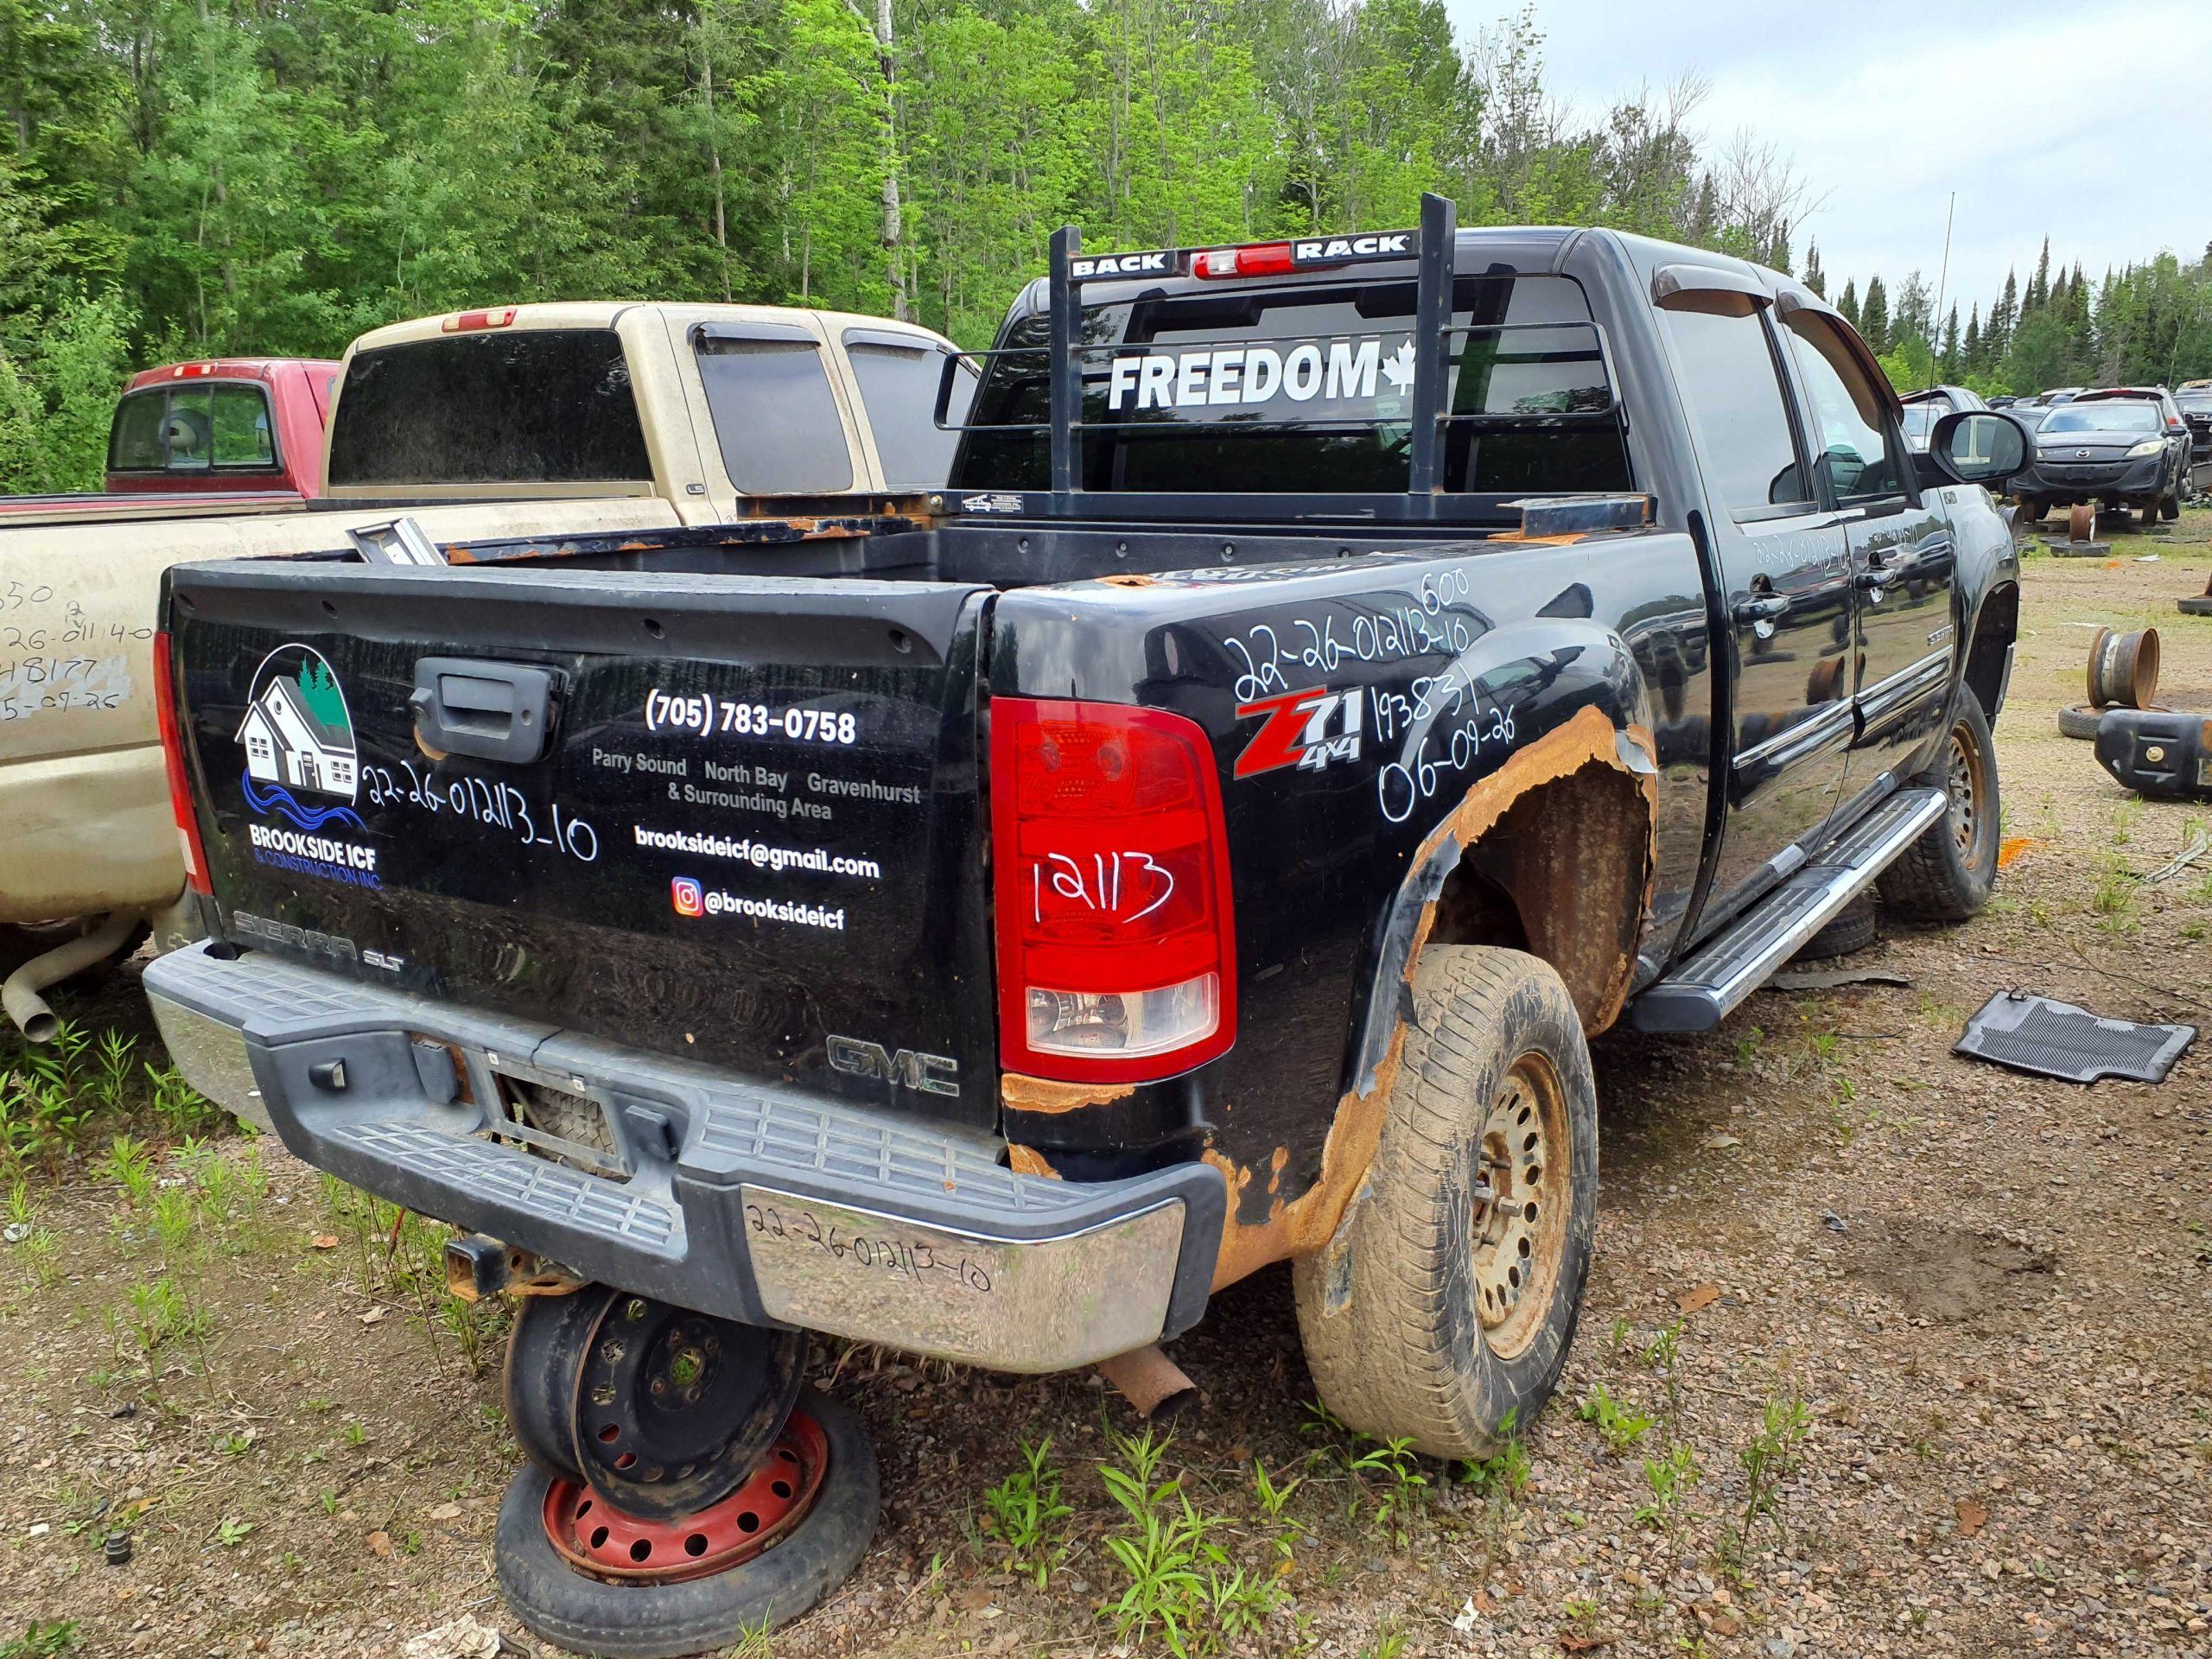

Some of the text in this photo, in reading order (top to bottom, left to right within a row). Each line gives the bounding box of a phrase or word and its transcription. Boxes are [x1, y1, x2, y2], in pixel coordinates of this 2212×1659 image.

[1072, 235, 1408, 276] BACK RACK
[1109, 340, 1381, 410] FREEDOM
[1421, 569, 1468, 615] 600
[645, 689, 856, 744] (705) 783-0758
[1370, 662, 1479, 742] 193831
[1235, 684, 1363, 780] Z71
[593, 748, 921, 804] Parry Sound North Bay Gravenhurst
[1379, 704, 1515, 822] 06-09-26
[667, 782, 832, 821] & Surrounding Area
[249, 823, 376, 872] BROOKSIDE ICF
[253, 848, 384, 891] & CONSTRUCTION INC
[634, 824, 880, 879] brooksideicf@gmail.com
[704, 891, 844, 930] @brooksideicf
[1033, 851, 1175, 924] 12113
[233, 910, 404, 972] SIERRA SLT
[826, 1034, 960, 1096] GMC
